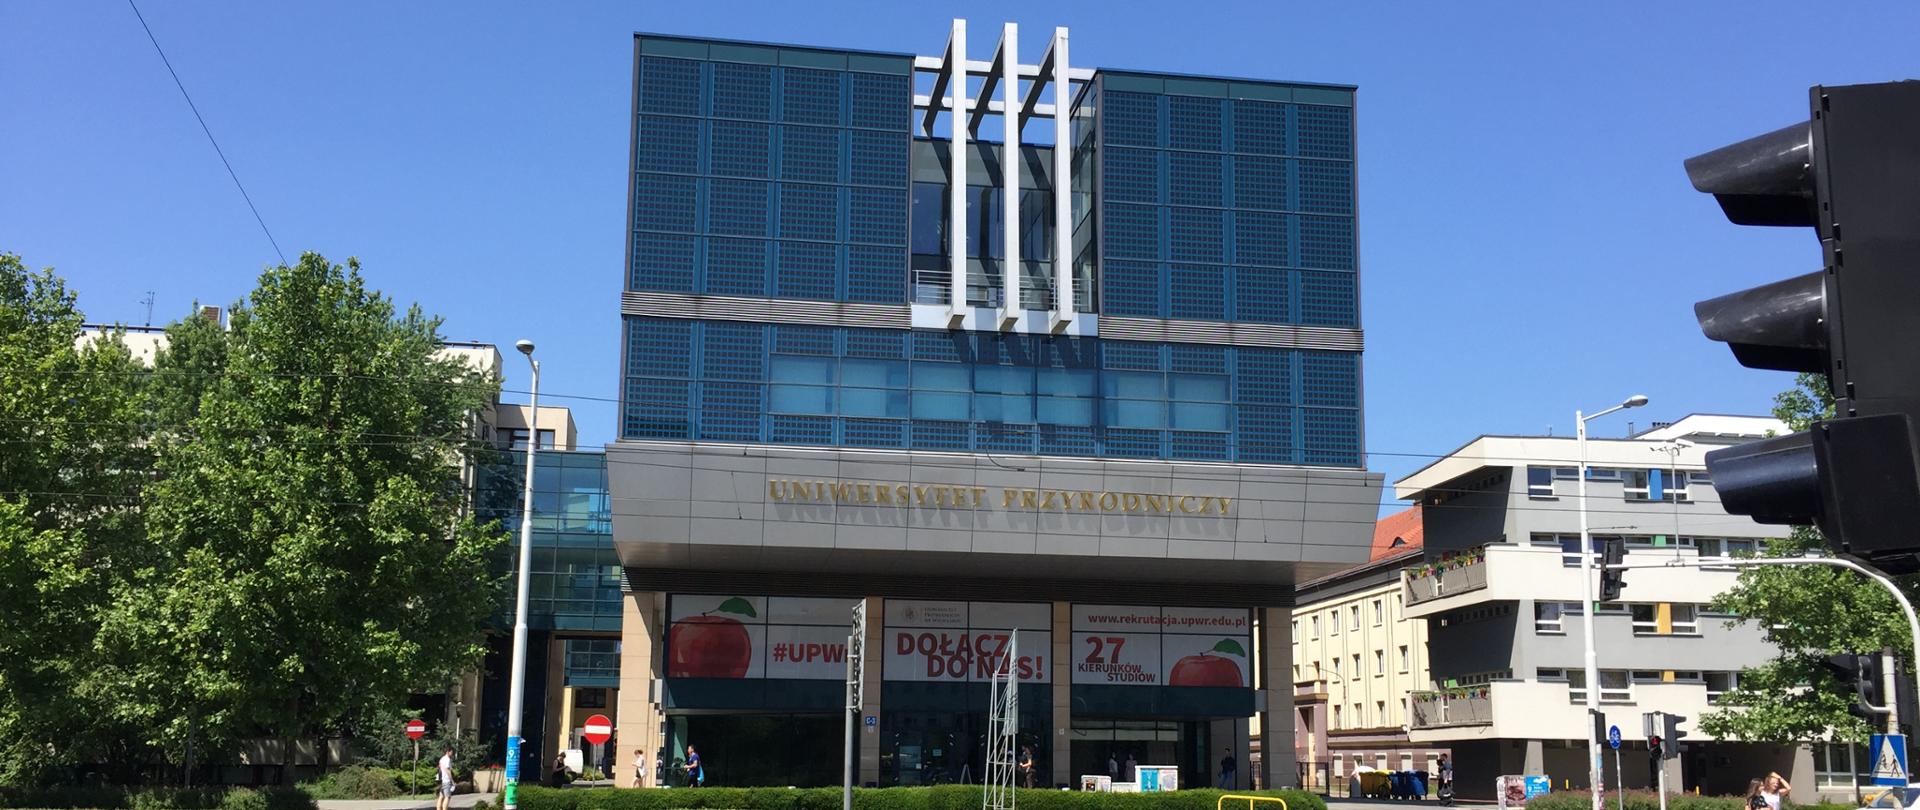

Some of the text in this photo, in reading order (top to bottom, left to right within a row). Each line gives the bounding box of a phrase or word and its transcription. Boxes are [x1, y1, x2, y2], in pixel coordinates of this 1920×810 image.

[769, 480, 1232, 515] UNIWERSYTET PRZYRODNICZY
[1088, 614, 1246, 628] www.rekrutacja.upwr.edu.pl
[897, 632, 1010, 662] DOŁĄCZ
[1085, 636, 1126, 664] 27
[927, 654, 1044, 679] DO NAS!
[1078, 661, 1142, 673] KIERUNKÓW
[1107, 671, 1156, 682] STUDIÓW
